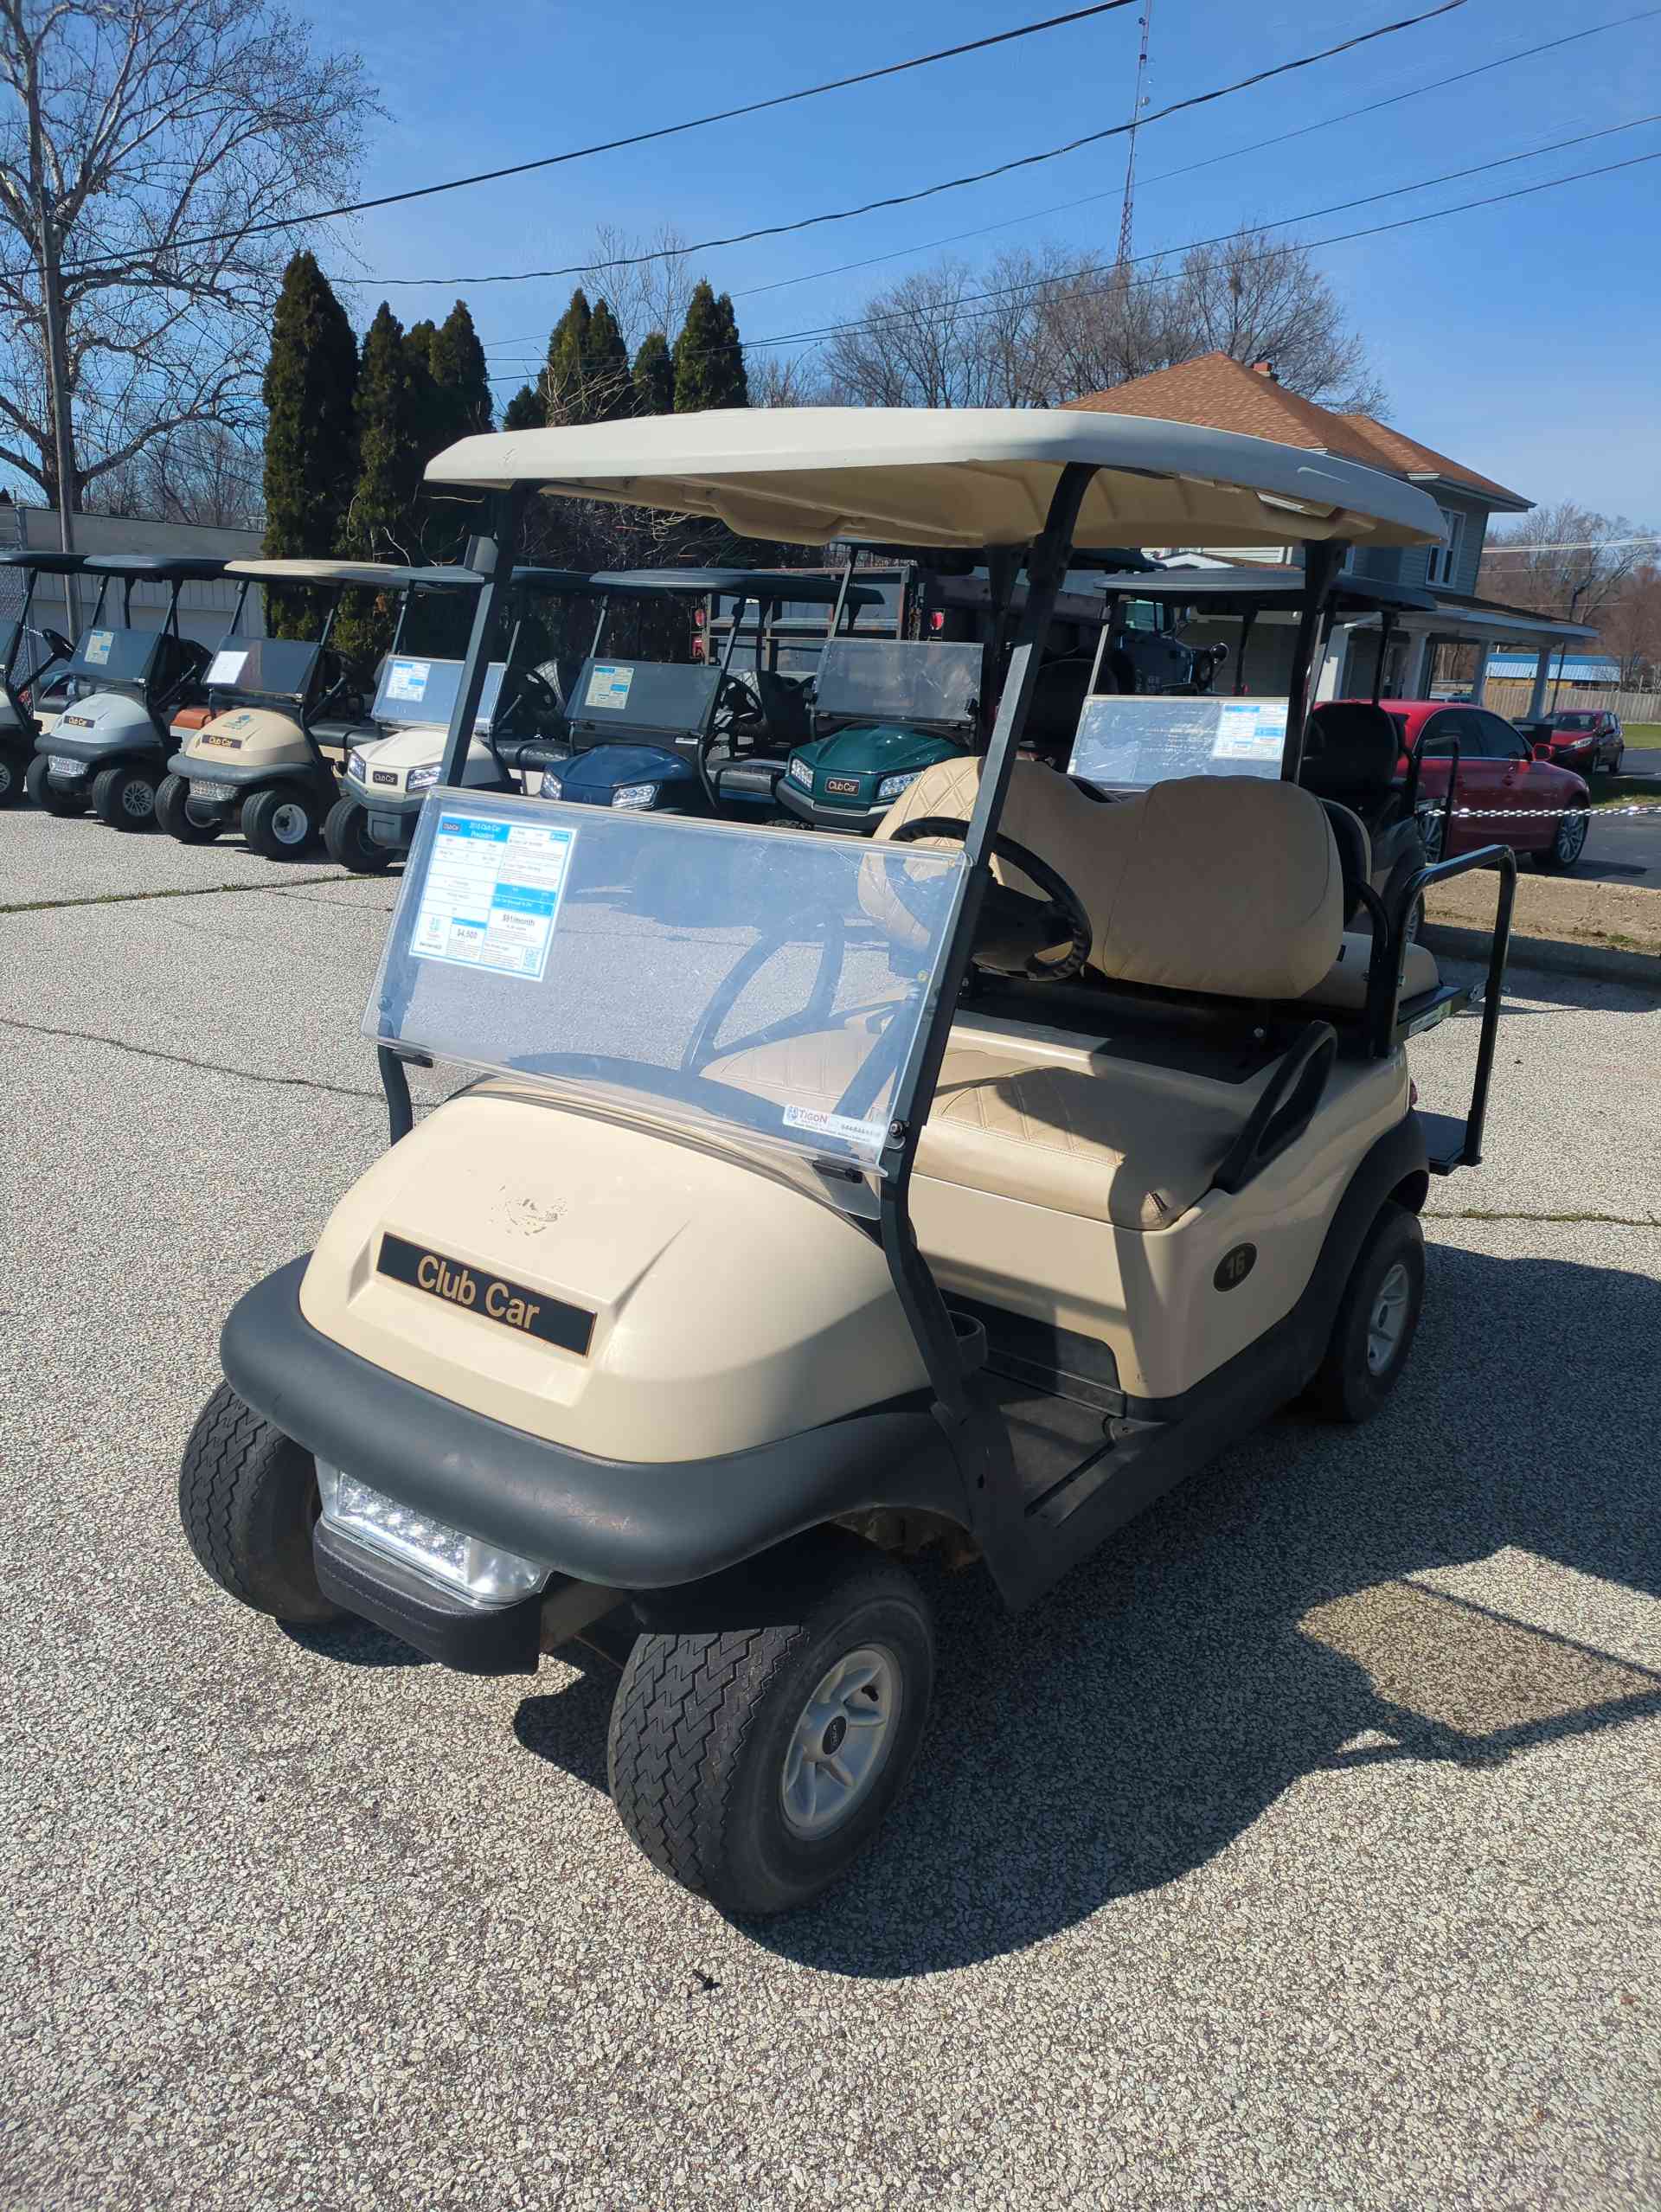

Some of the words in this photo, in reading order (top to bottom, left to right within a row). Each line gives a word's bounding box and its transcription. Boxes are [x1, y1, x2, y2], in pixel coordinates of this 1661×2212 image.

[208, 736, 221, 745] Club
[375, 773, 385, 782] Club
[386, 774, 395, 783] Car
[828, 780, 843, 790] Club
[843, 782, 856, 792] Car
[1225, 1251, 1246, 1279] 16
[417, 1254, 477, 1305] Club
[484, 1282, 540, 1329] Car
